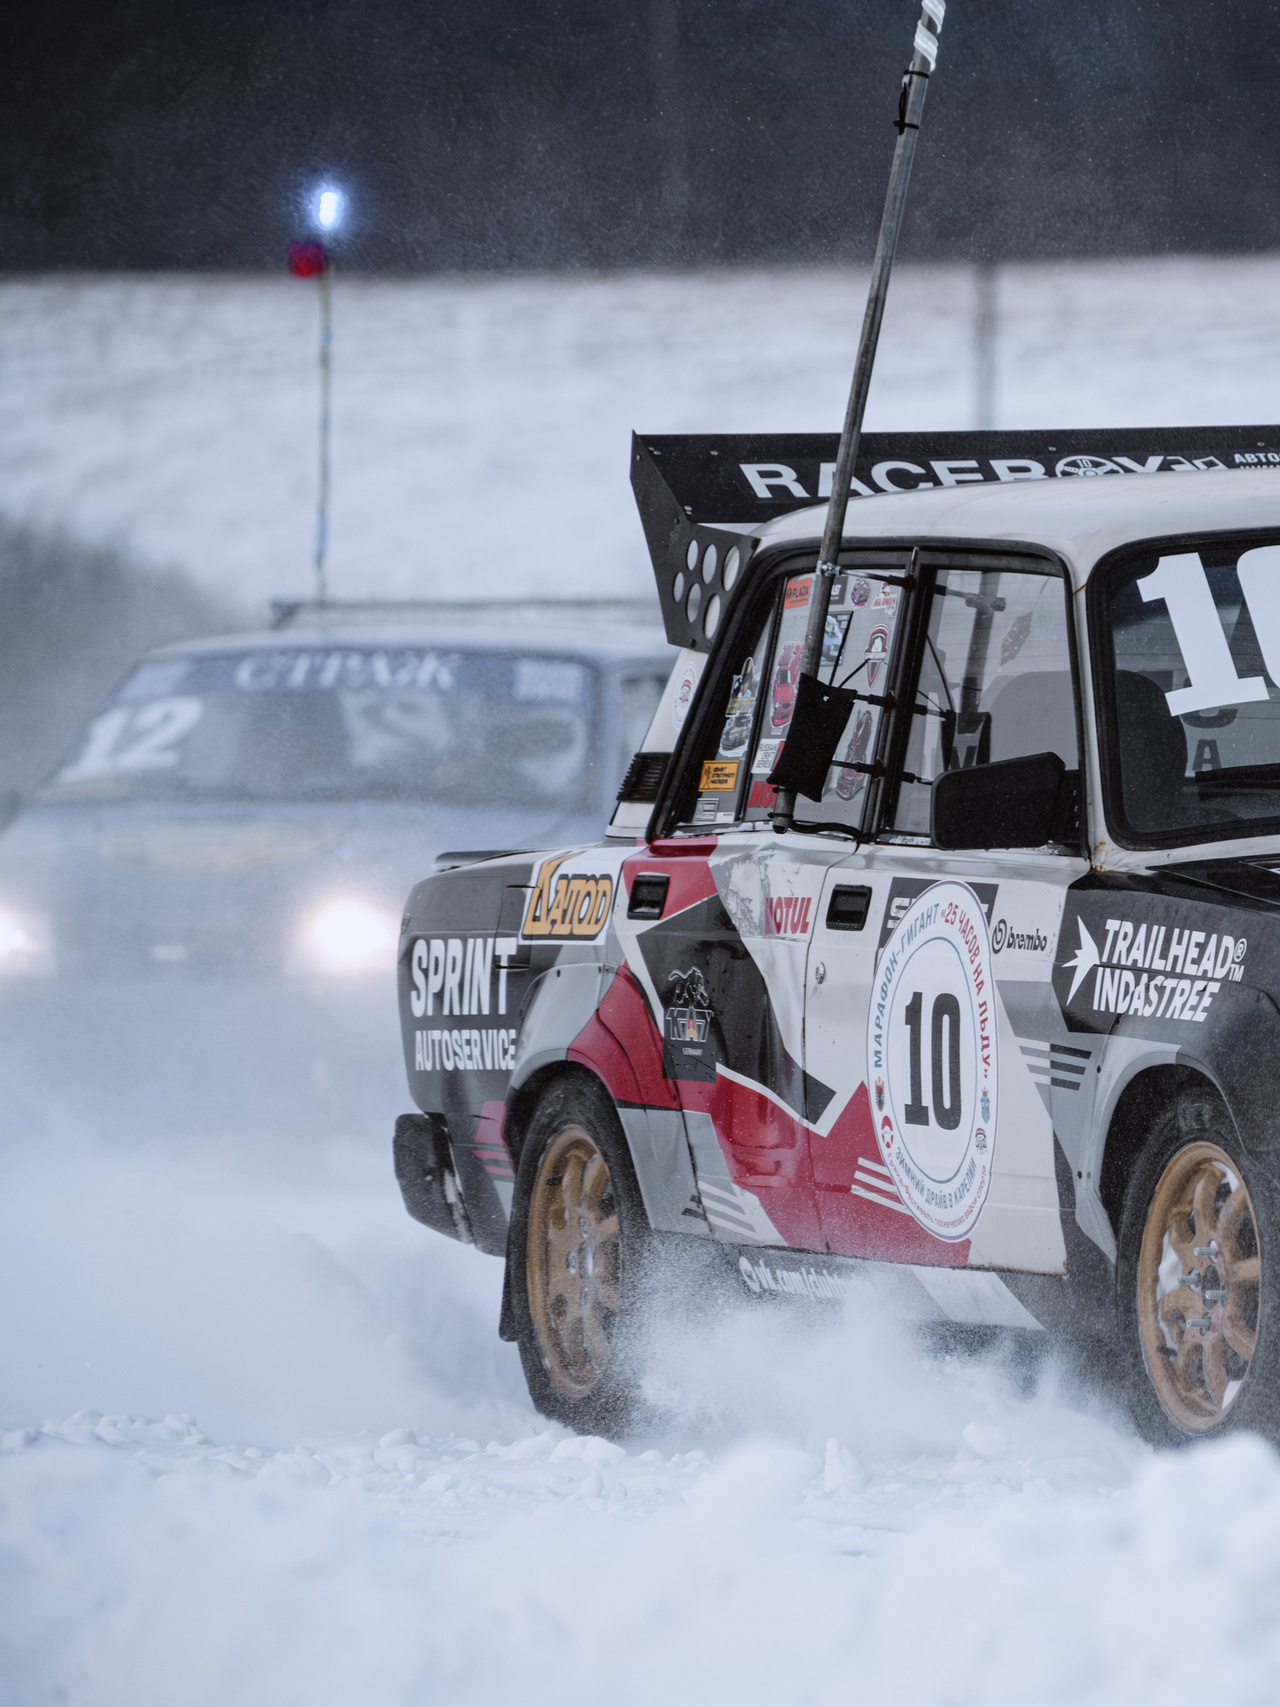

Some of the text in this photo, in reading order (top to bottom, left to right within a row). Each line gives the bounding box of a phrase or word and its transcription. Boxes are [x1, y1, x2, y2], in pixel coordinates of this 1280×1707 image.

[58, 697, 203, 783] 12
[765, 896, 812, 934] MOTUL
[1006, 926, 1047, 951] brembo
[410, 937, 517, 1018] SPRINT
[874, 903, 940, 1067] МАРАФОН-ГИГАНТ
[958, 910, 981, 965] ЧАСОВ
[973, 962, 985, 996] НА
[1093, 967, 1221, 1022] INDASTREE
[415, 1029, 517, 1072] AUTOSERVICE
[904, 991, 962, 1131] 10
[895, 1146, 925, 1198] ЗИМНИЙ
[925, 1188, 948, 1209] ДРАЙВ
[953, 1156, 977, 1206] КАРЕЛИИ
